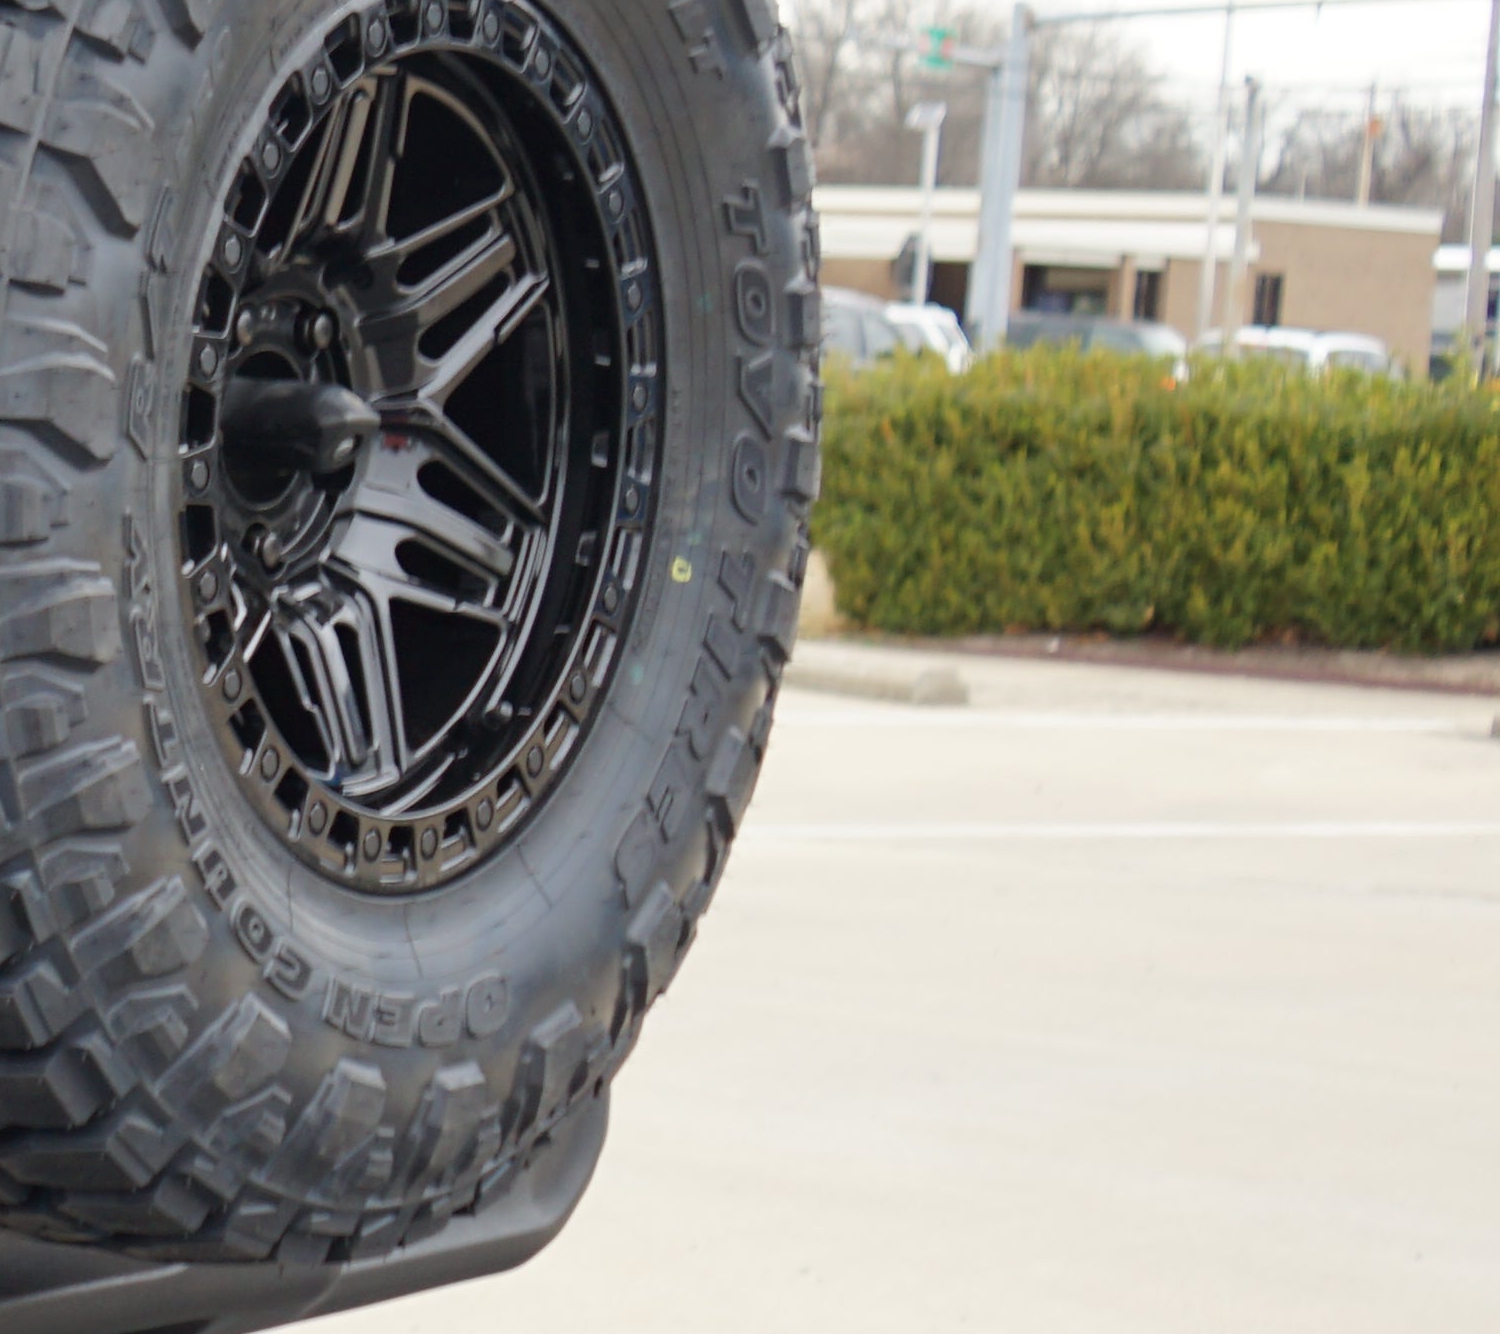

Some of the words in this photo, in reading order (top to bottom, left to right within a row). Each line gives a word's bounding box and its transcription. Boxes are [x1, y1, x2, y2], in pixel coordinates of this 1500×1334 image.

[721, 175, 781, 527] TOYO
[613, 547, 758, 909] TIRES
[320, 966, 510, 1051] OPEN
